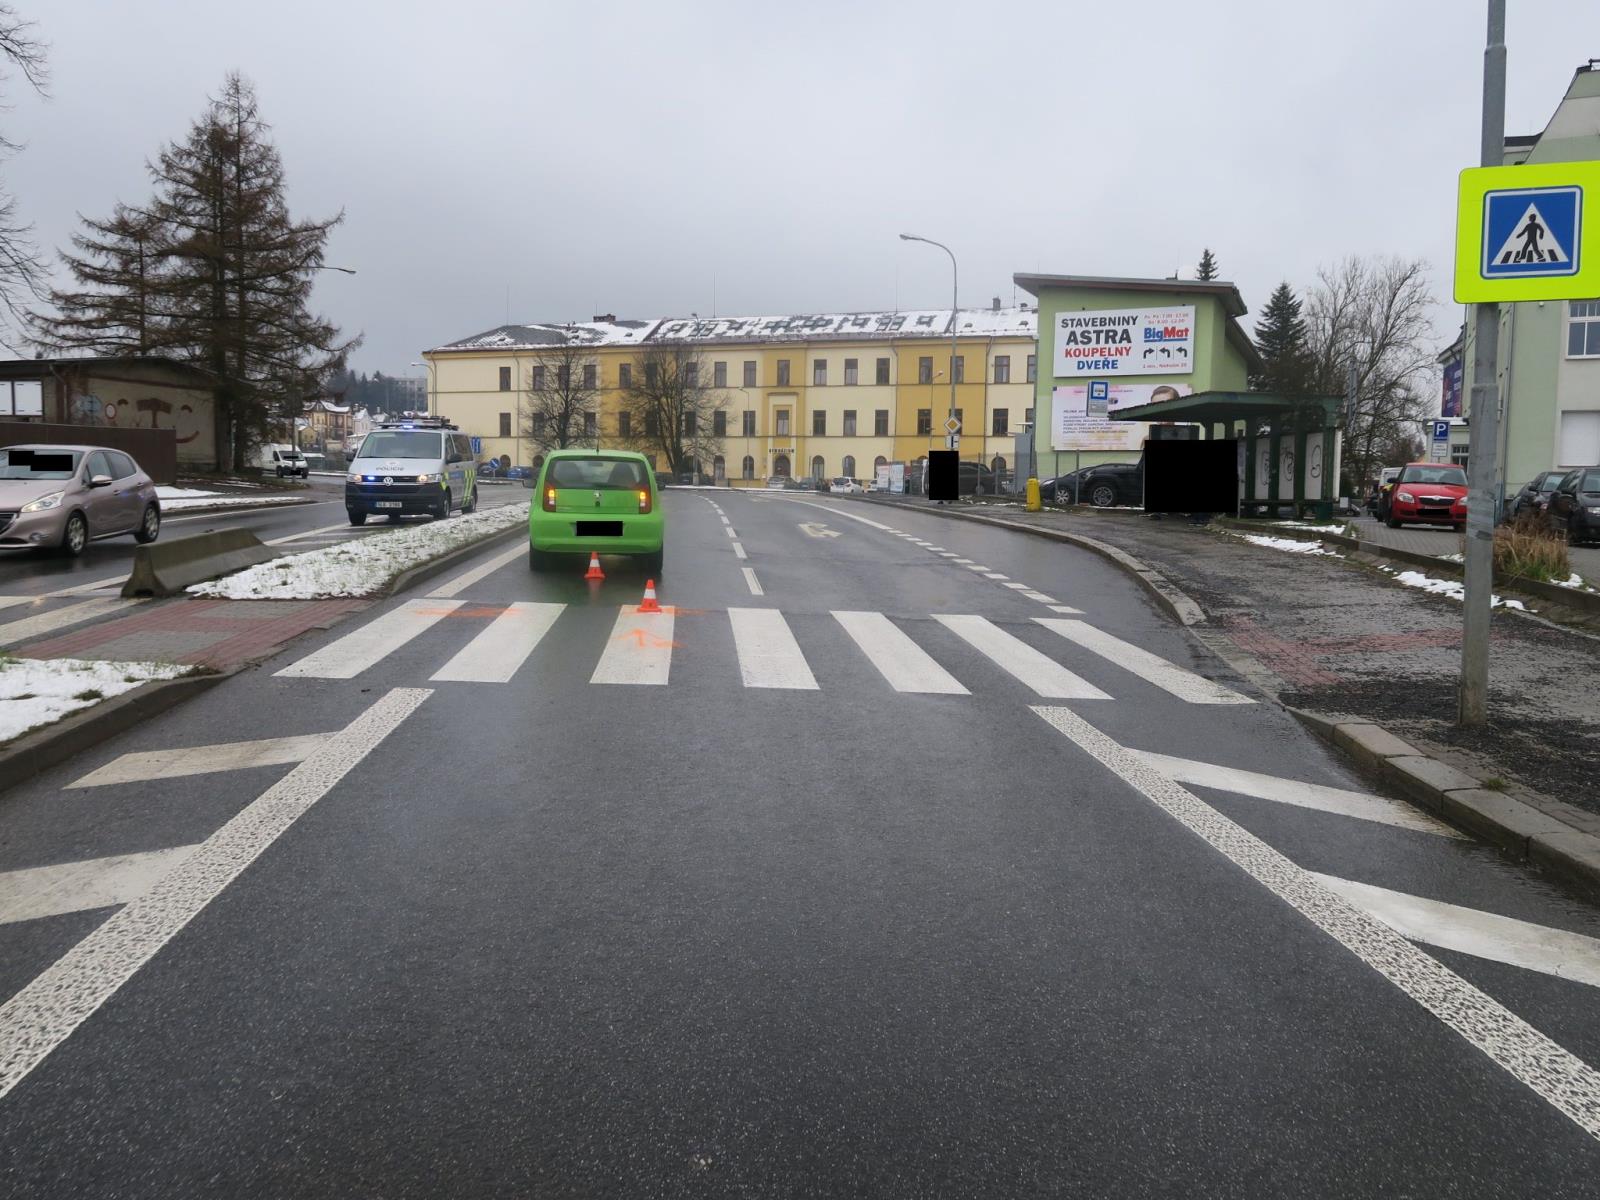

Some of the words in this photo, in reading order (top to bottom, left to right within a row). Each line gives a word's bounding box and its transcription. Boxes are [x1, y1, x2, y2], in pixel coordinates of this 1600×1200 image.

[1061, 315, 1139, 328] STAVEBNINY
[1066, 329, 1132, 345] ASTRA
[1144, 326, 1189, 341] BigMat
[1065, 346, 1132, 358] KOUPELNY
[1077, 357, 1118, 370] DVEŘE
[1436, 423, 1447, 435] P
